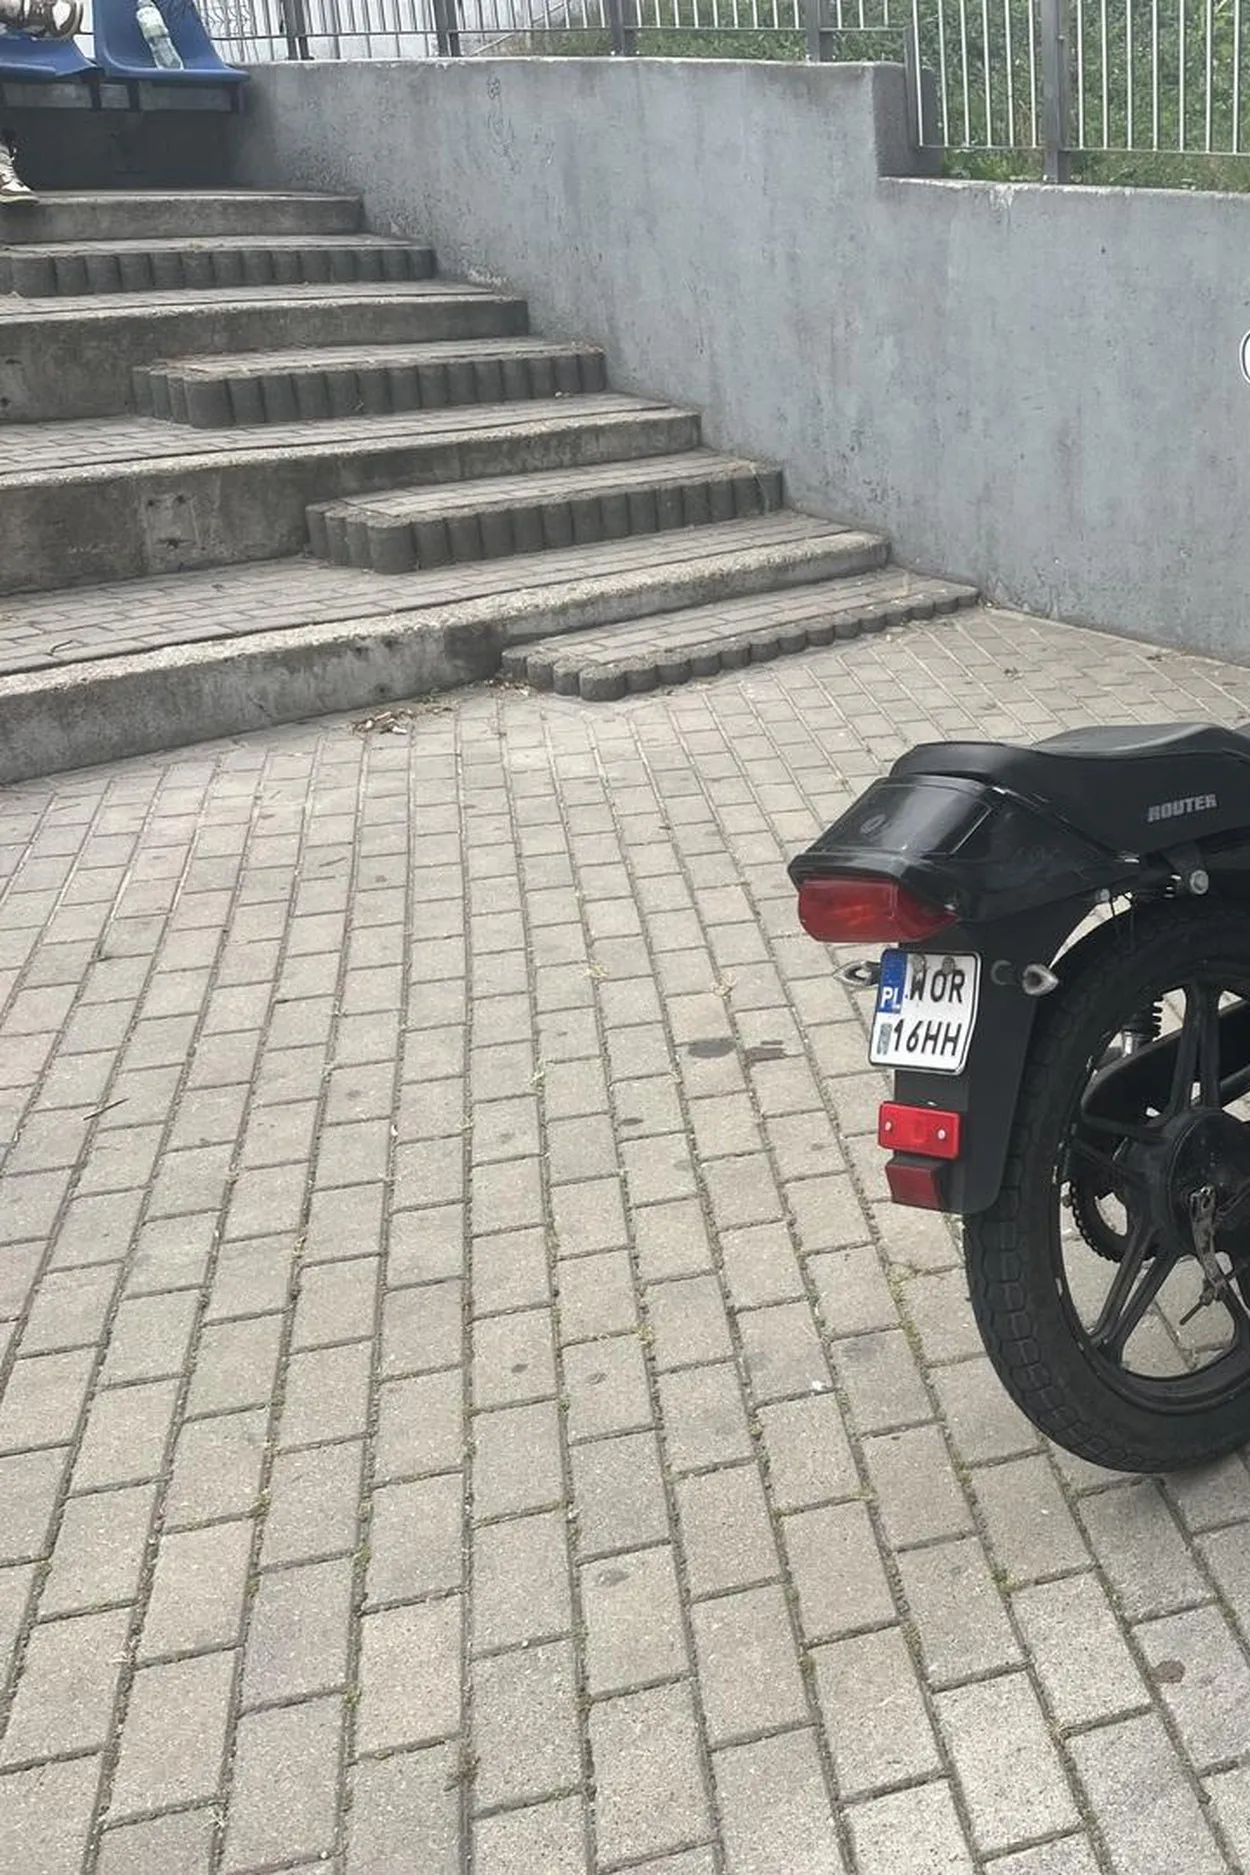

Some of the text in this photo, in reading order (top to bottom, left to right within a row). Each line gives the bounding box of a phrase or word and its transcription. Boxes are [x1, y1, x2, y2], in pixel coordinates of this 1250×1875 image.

[1147, 793, 1218, 822] ROUTER
[880, 986, 901, 1009] PL
[909, 967, 965, 1004] WOR
[893, 1018, 962, 1056] 16HH
